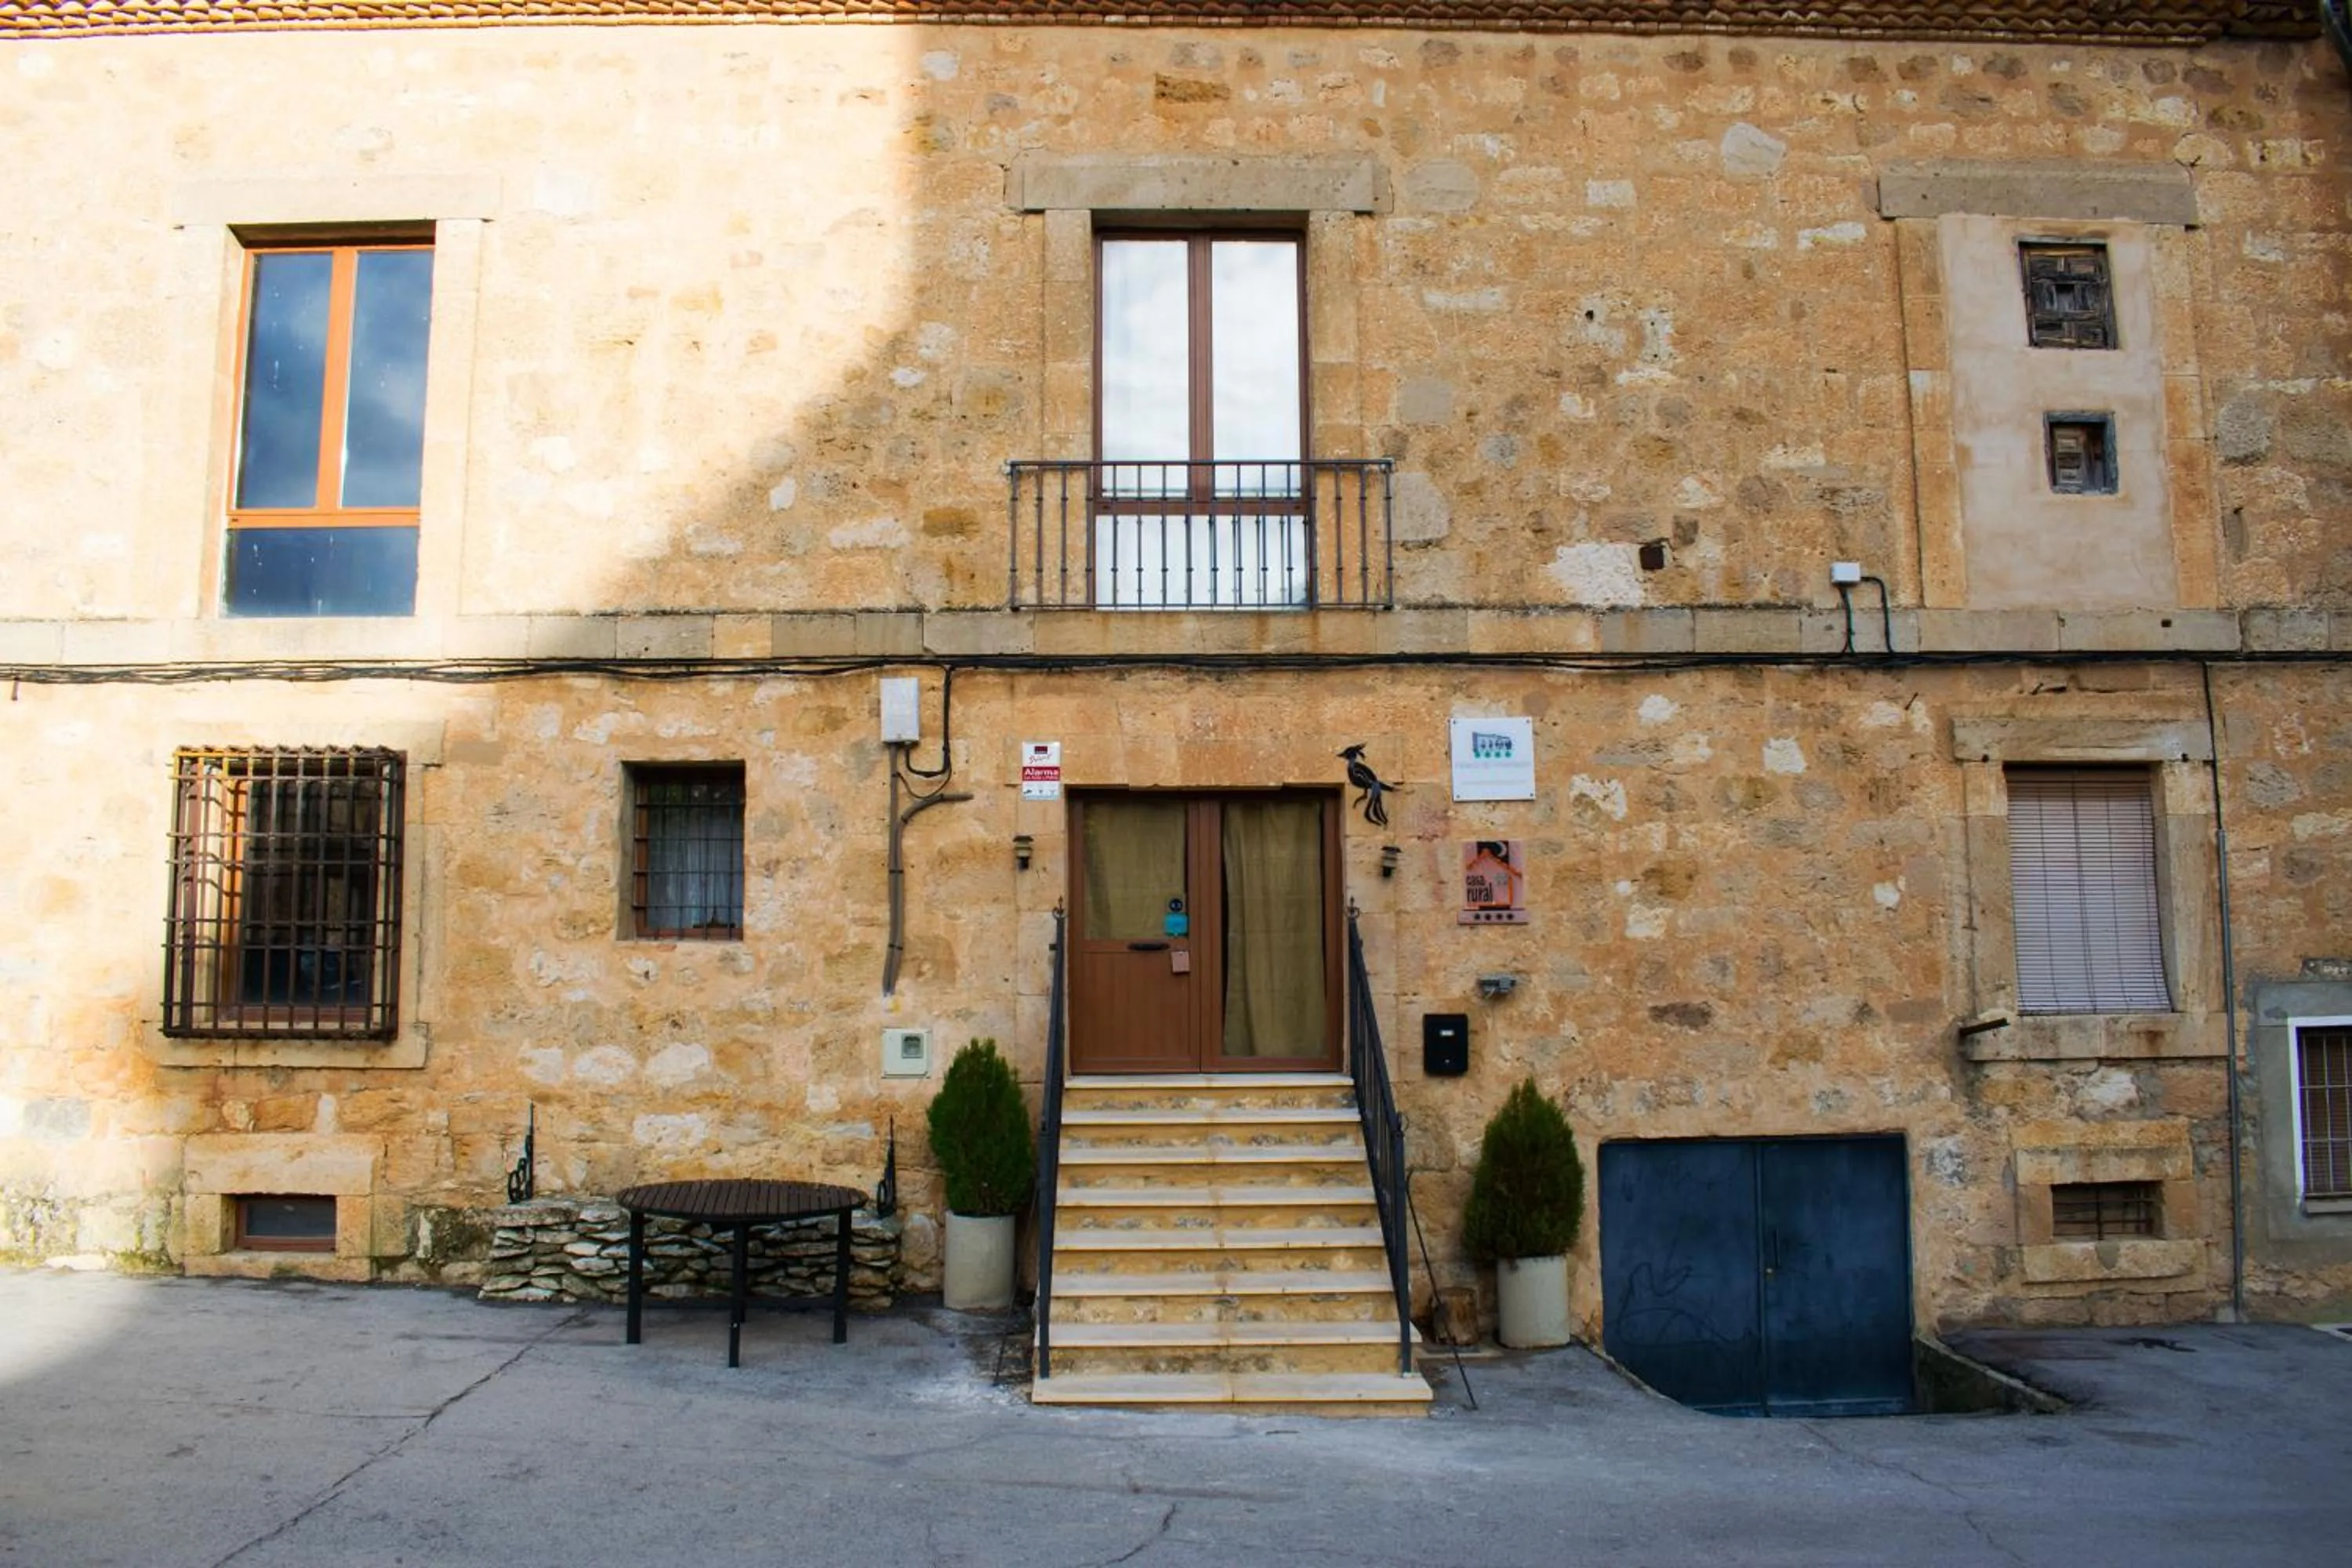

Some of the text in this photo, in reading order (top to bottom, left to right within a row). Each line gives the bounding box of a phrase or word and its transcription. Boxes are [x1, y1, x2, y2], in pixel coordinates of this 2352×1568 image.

[1025, 768, 1058, 776] Alarma
[1466, 874, 1485, 885] casa
[1467, 882, 1494, 903] rural
